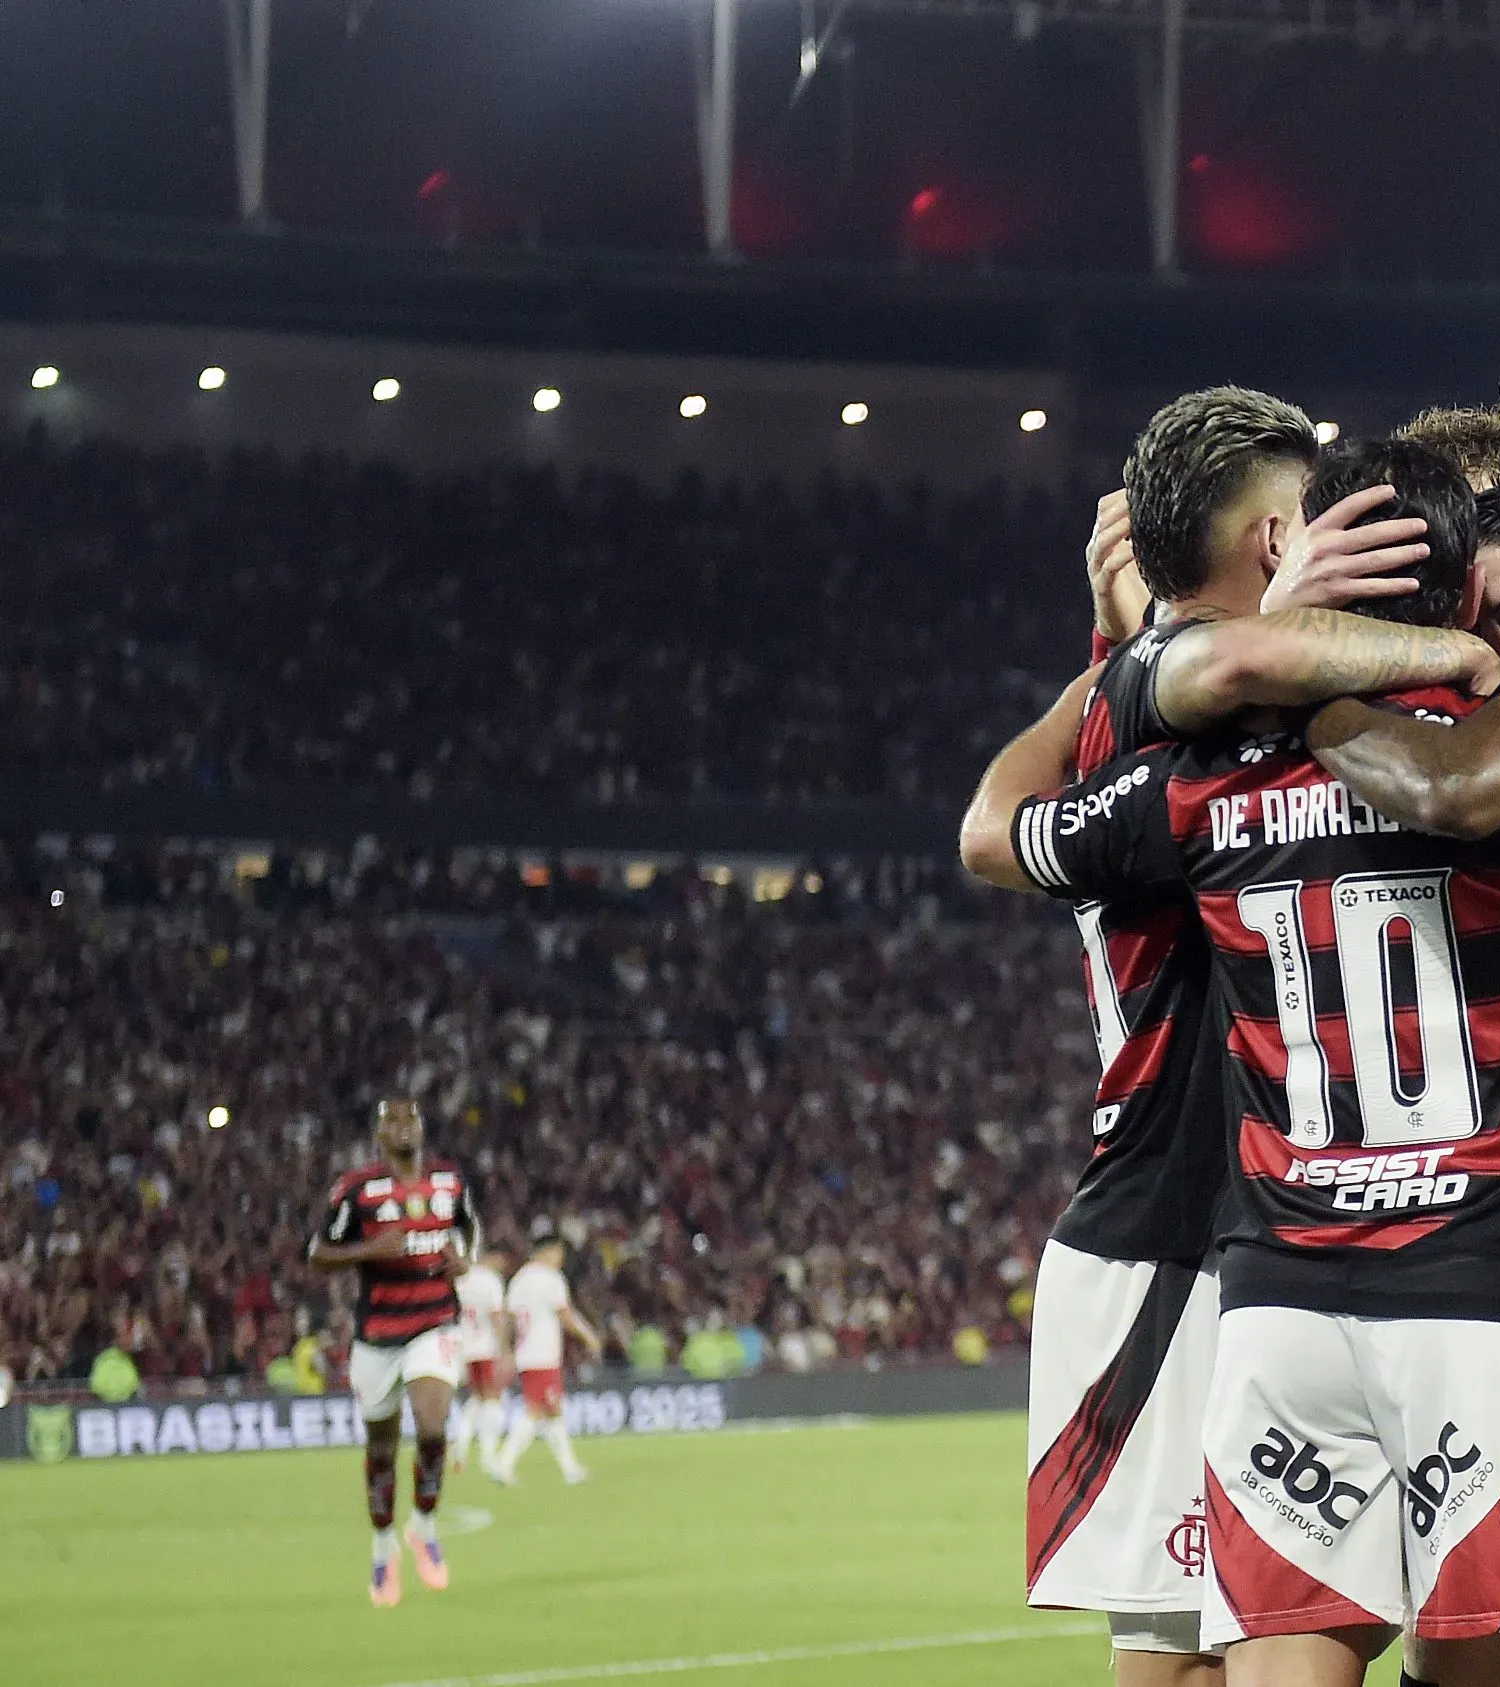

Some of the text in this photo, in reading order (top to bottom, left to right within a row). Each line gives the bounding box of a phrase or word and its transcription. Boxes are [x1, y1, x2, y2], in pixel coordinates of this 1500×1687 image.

[1208, 793, 1250, 851] DE
[1364, 885, 1436, 903] TEXACO
[1275, 911, 1296, 985] TEXACO
[1237, 867, 1482, 1150] 10
[1284, 1147, 1456, 1187] ASSIST
[1332, 1173, 1470, 1211] CARD
[1240, 1470, 1334, 1547] da construção
[1251, 1426, 1369, 1530] abc
[1407, 1421, 1481, 1538] abc
